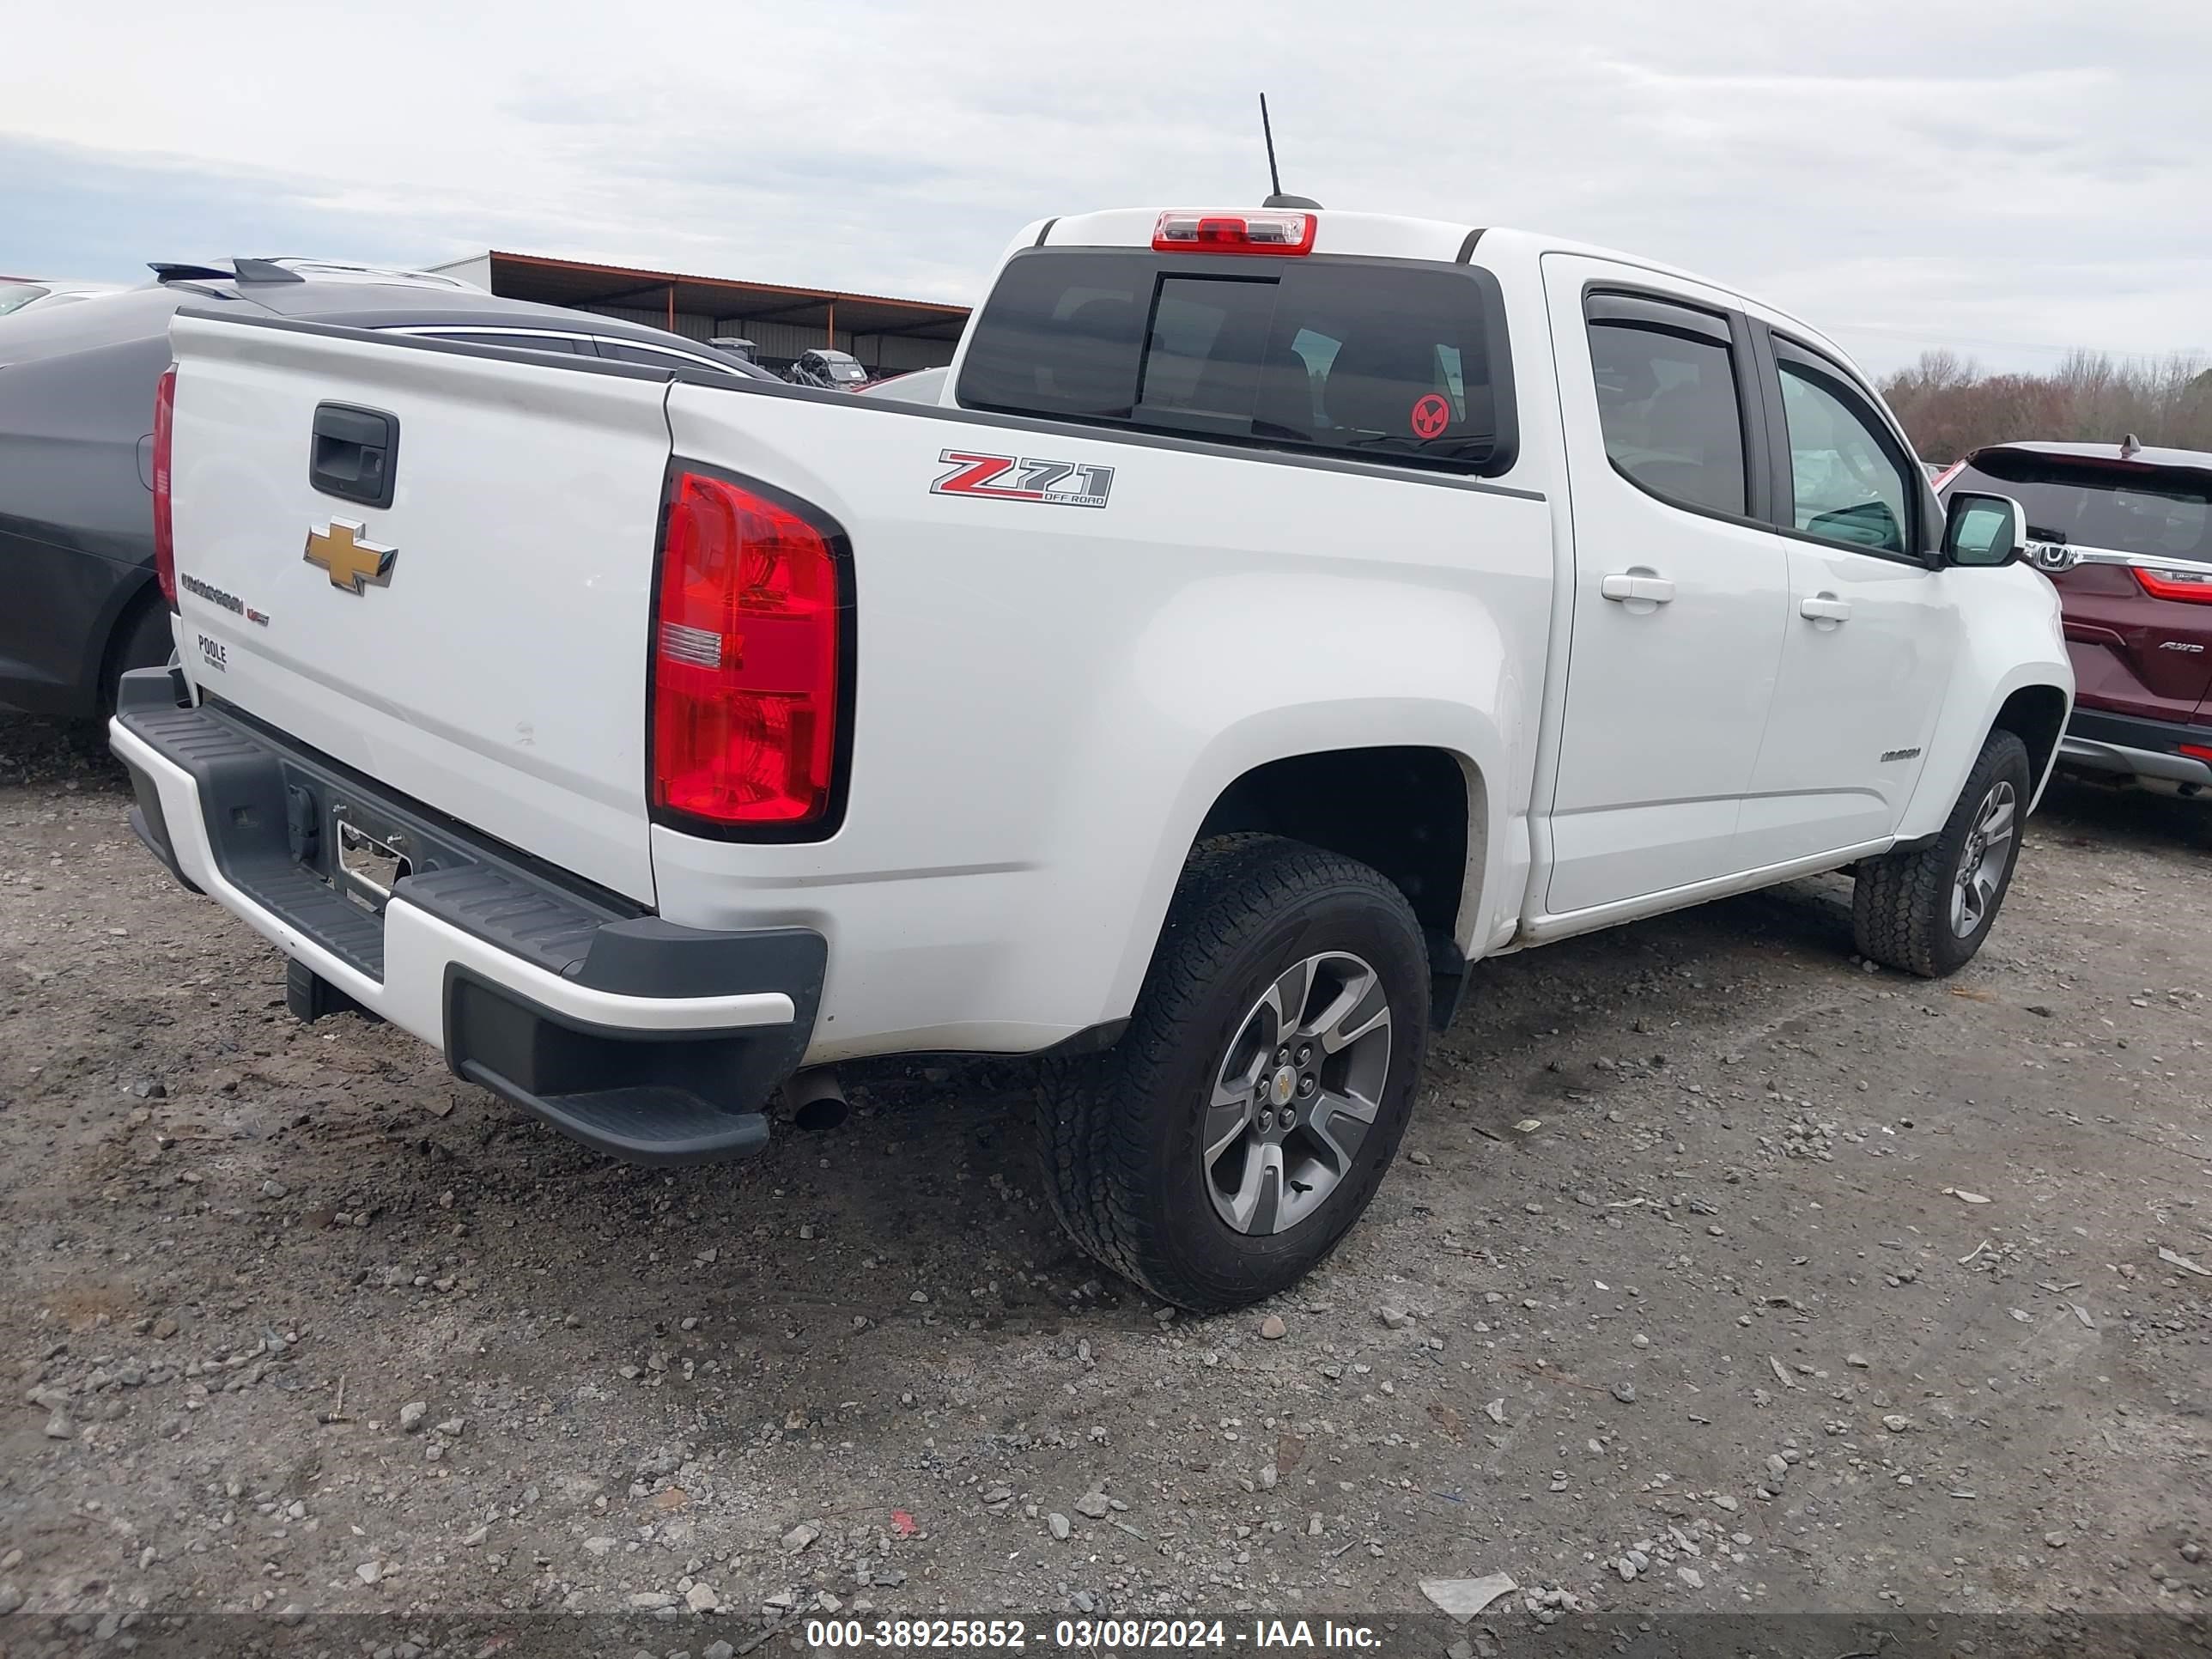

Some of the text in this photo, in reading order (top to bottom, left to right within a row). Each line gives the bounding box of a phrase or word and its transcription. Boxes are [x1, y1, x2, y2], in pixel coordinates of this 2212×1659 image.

[930, 448, 1115, 509] Z71
[1044, 493, 1104, 505] OFF ROAD
[198, 634, 227, 664] POOLE
